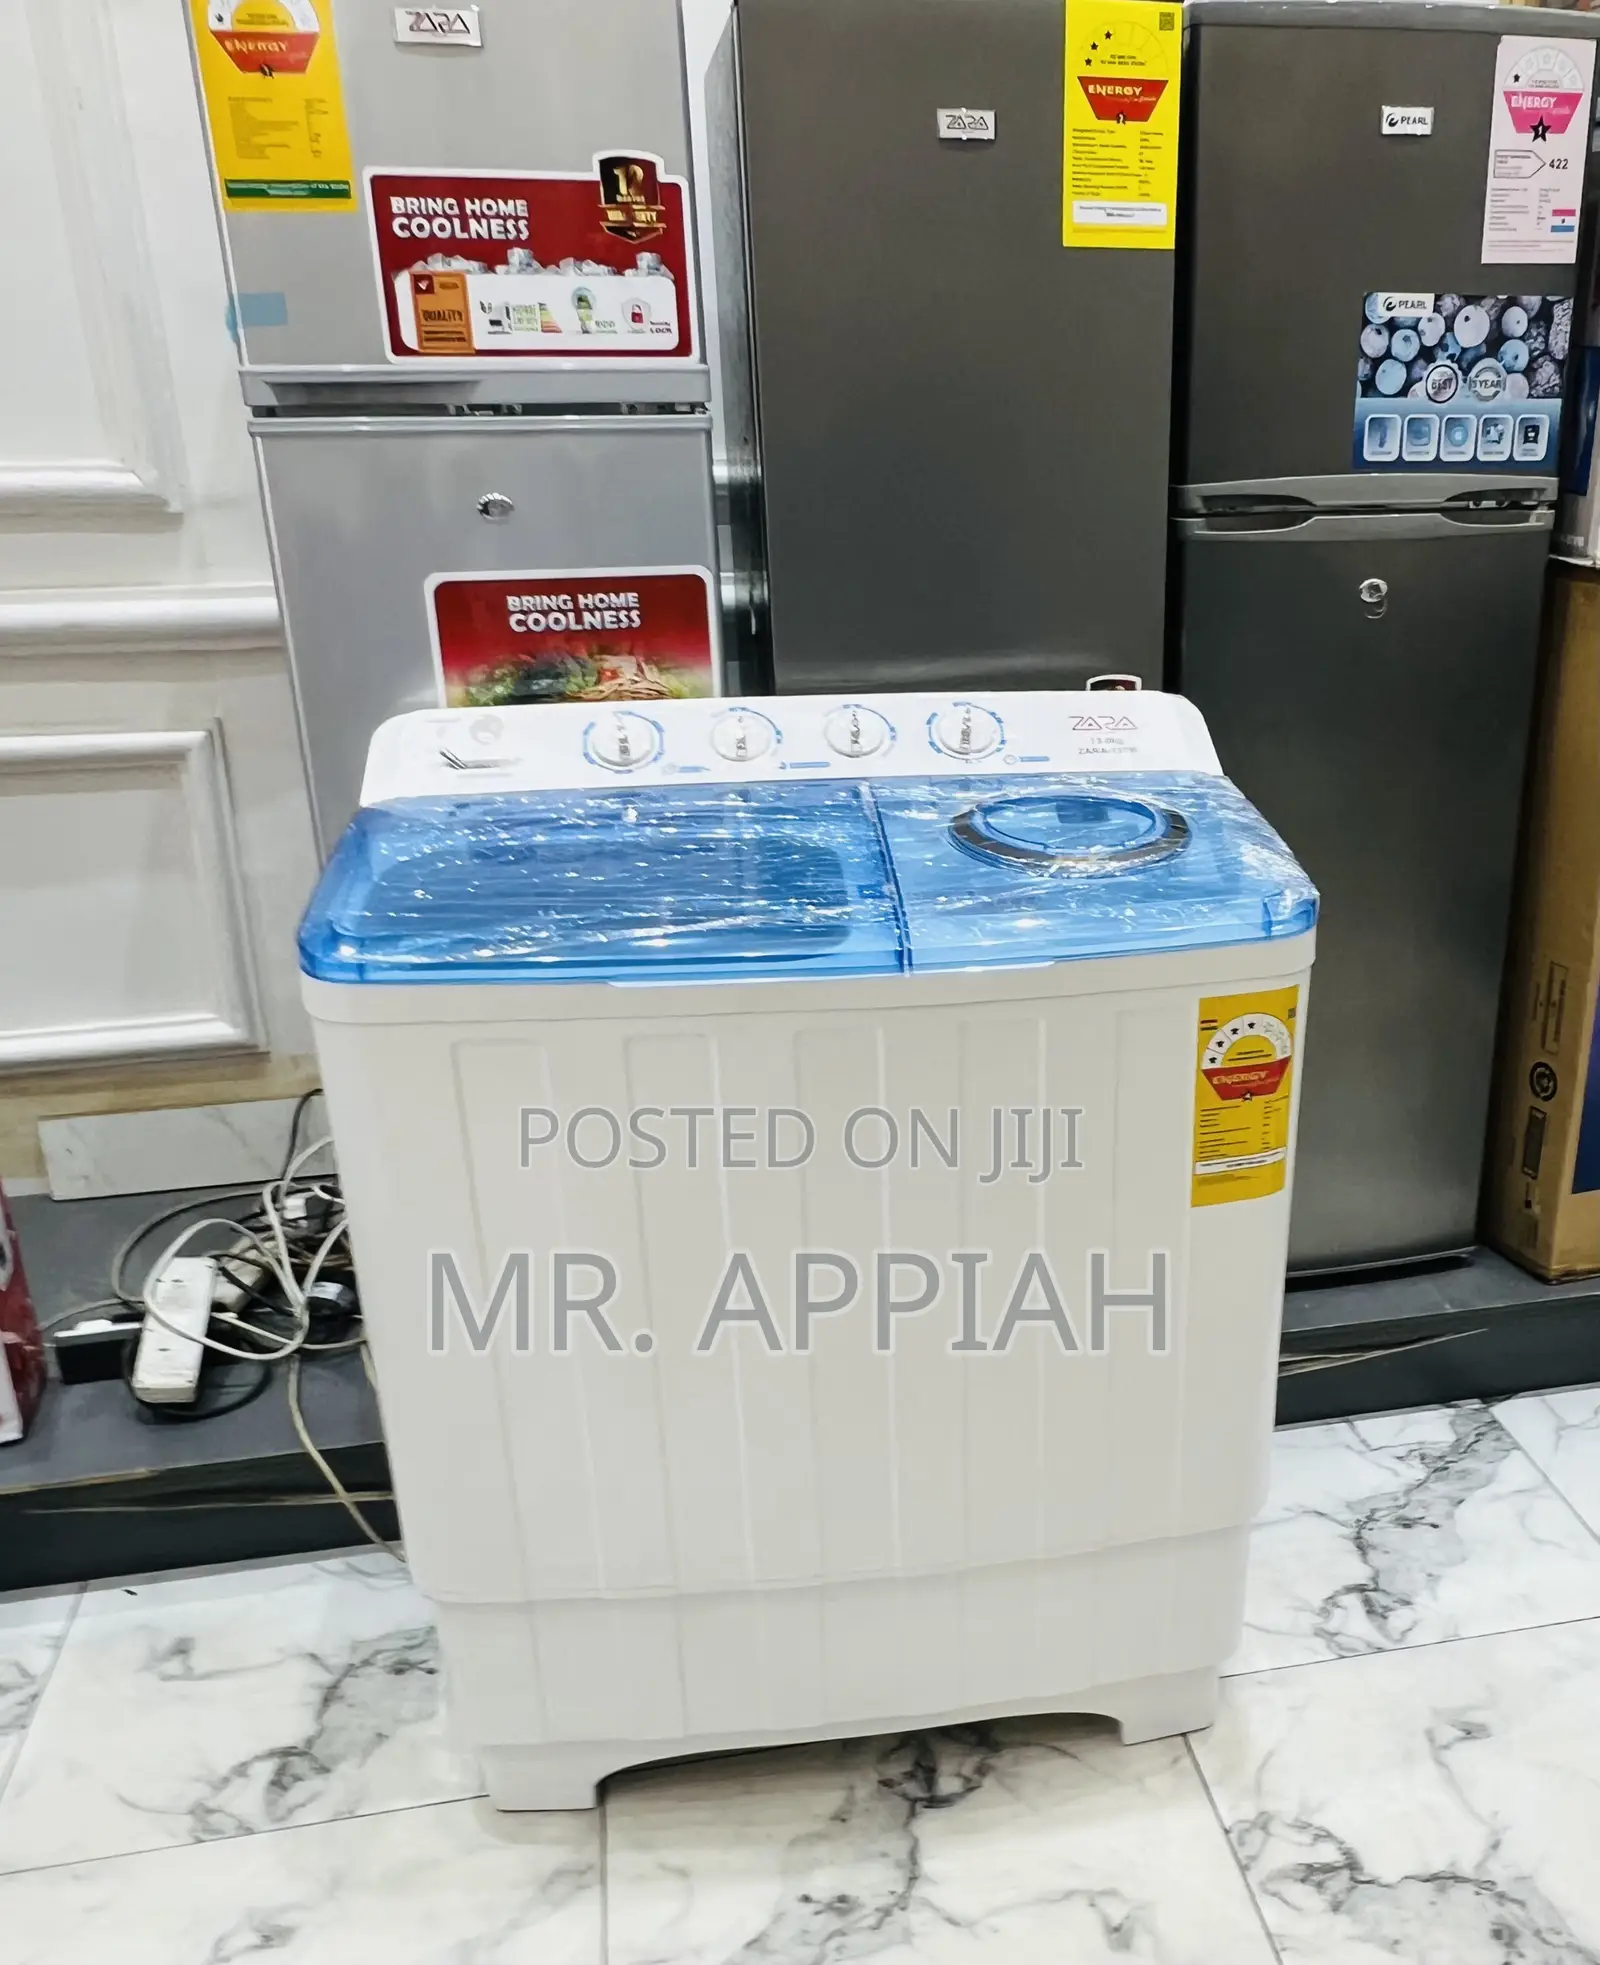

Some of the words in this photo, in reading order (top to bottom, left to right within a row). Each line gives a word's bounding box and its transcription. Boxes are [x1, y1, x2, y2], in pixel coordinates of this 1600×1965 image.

[1088, 84, 1142, 96] ENERGY
[1511, 93, 1557, 109] ENERGY
[945, 114, 989, 130] ZARA
[1400, 116, 1428, 125] PEARL
[1549, 158, 1569, 170] 422
[390, 196, 460, 216] BRING
[464, 198, 529, 218] HOME
[391, 217, 529, 240] COOLNESS
[1398, 299, 1427, 310] PEARL
[422, 309, 464, 322] QUALITY
[506, 594, 574, 612] BRING
[578, 592, 640, 610] HOME
[509, 610, 641, 632] COOLNESS
[1068, 715, 1139, 731] ZARA
